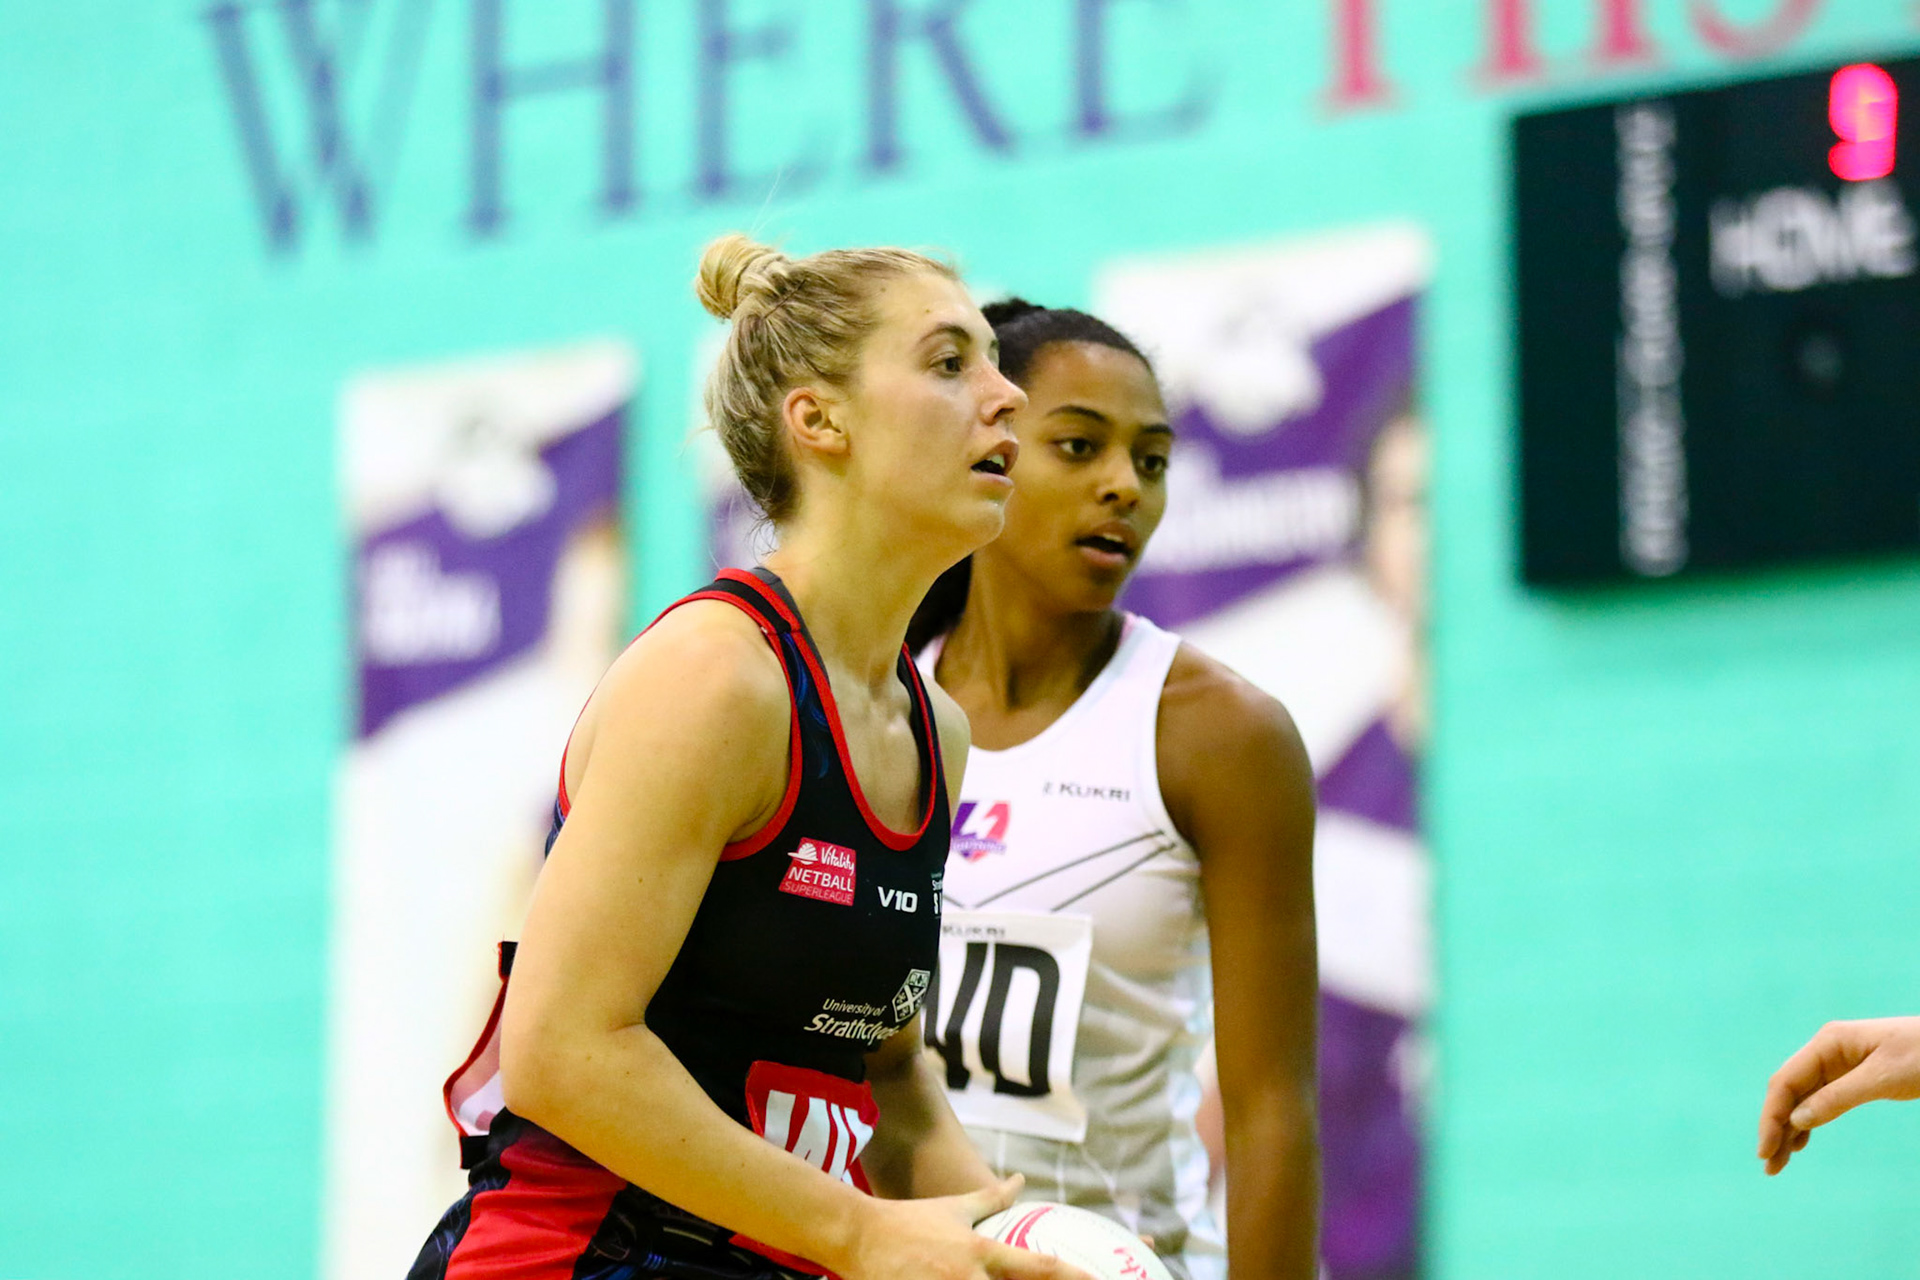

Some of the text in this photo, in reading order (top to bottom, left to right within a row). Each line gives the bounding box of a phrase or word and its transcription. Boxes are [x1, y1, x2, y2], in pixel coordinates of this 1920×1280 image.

[202, 0, 1228, 254] WHERE
[1710, 182, 1915, 297] HOME
[1059, 783, 1130, 803] KUKRI
[821, 845, 855, 876] Vitality
[788, 867, 854, 892] NETBALL
[784, 882, 853, 904] SUPERLEAGUE
[877, 886, 918, 914] V10
[822, 998, 886, 1017] University of
